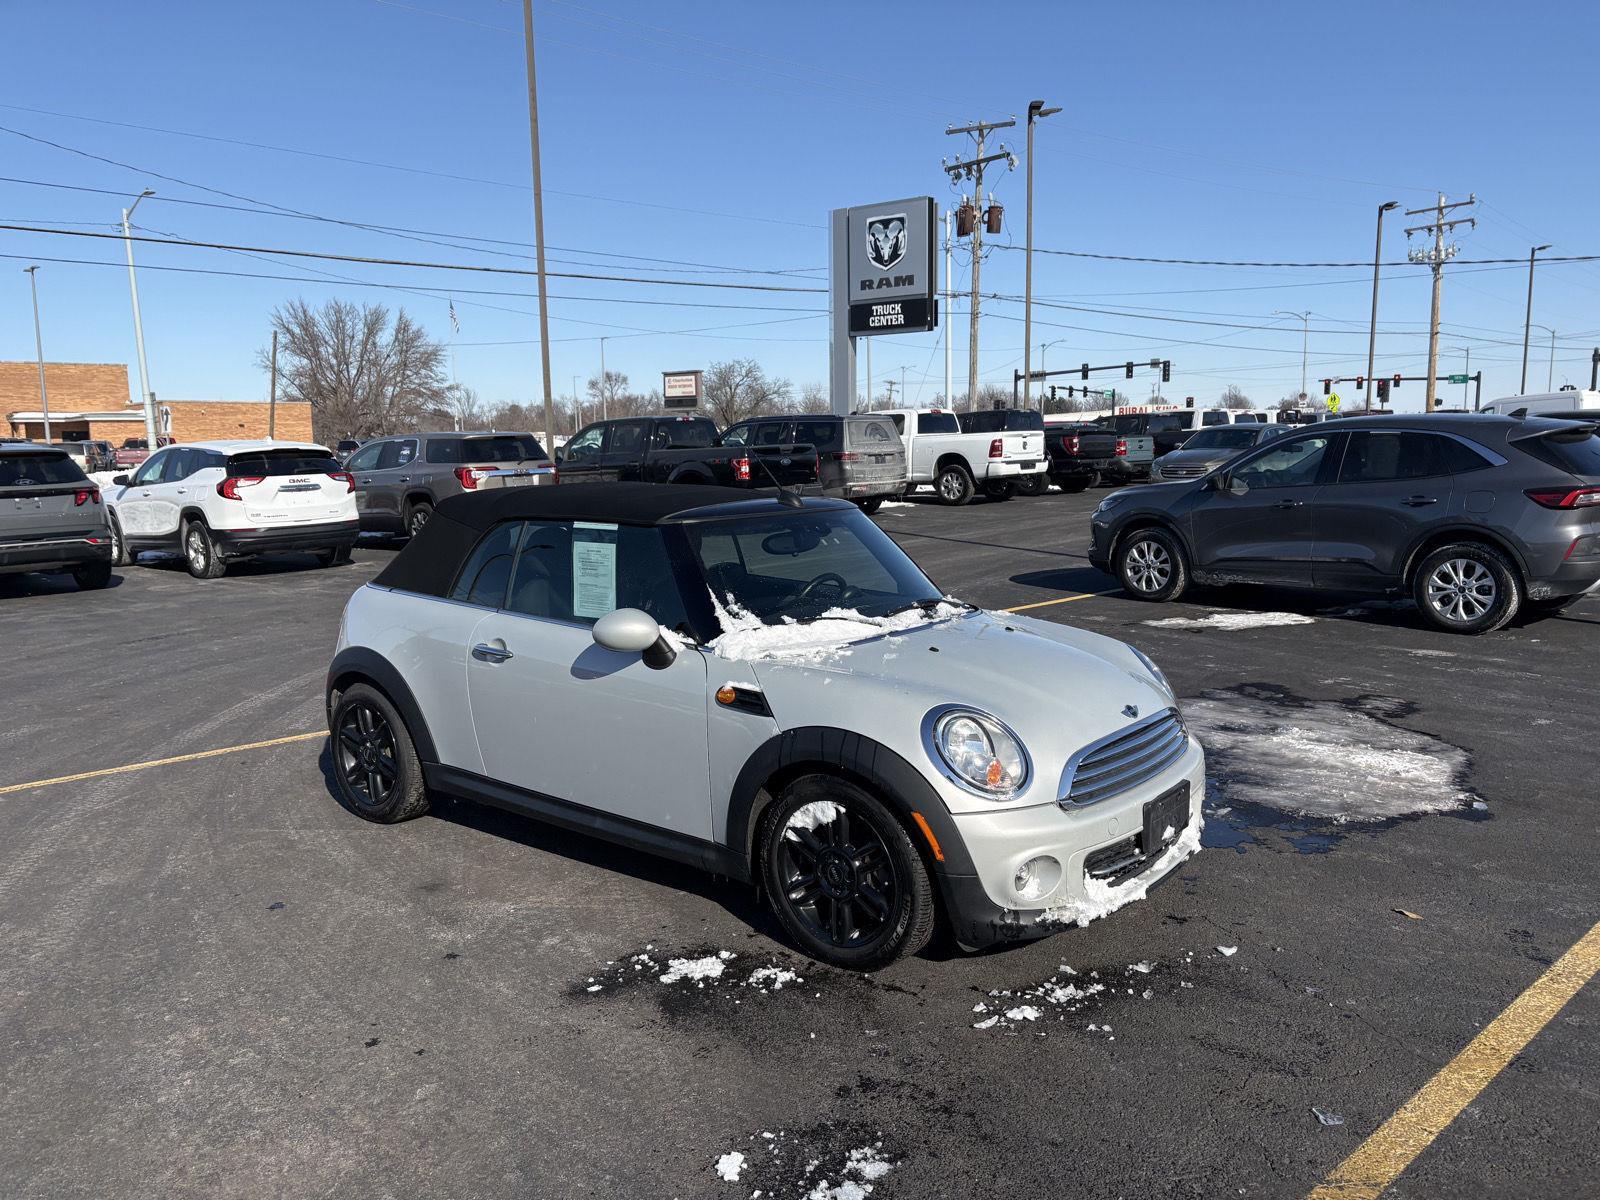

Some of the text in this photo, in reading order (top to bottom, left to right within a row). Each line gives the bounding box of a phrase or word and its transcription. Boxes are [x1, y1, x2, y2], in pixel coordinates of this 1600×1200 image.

[860, 274, 915, 291] RAM
[871, 303, 902, 316] TRUCK
[869, 314, 905, 327] CENTER
